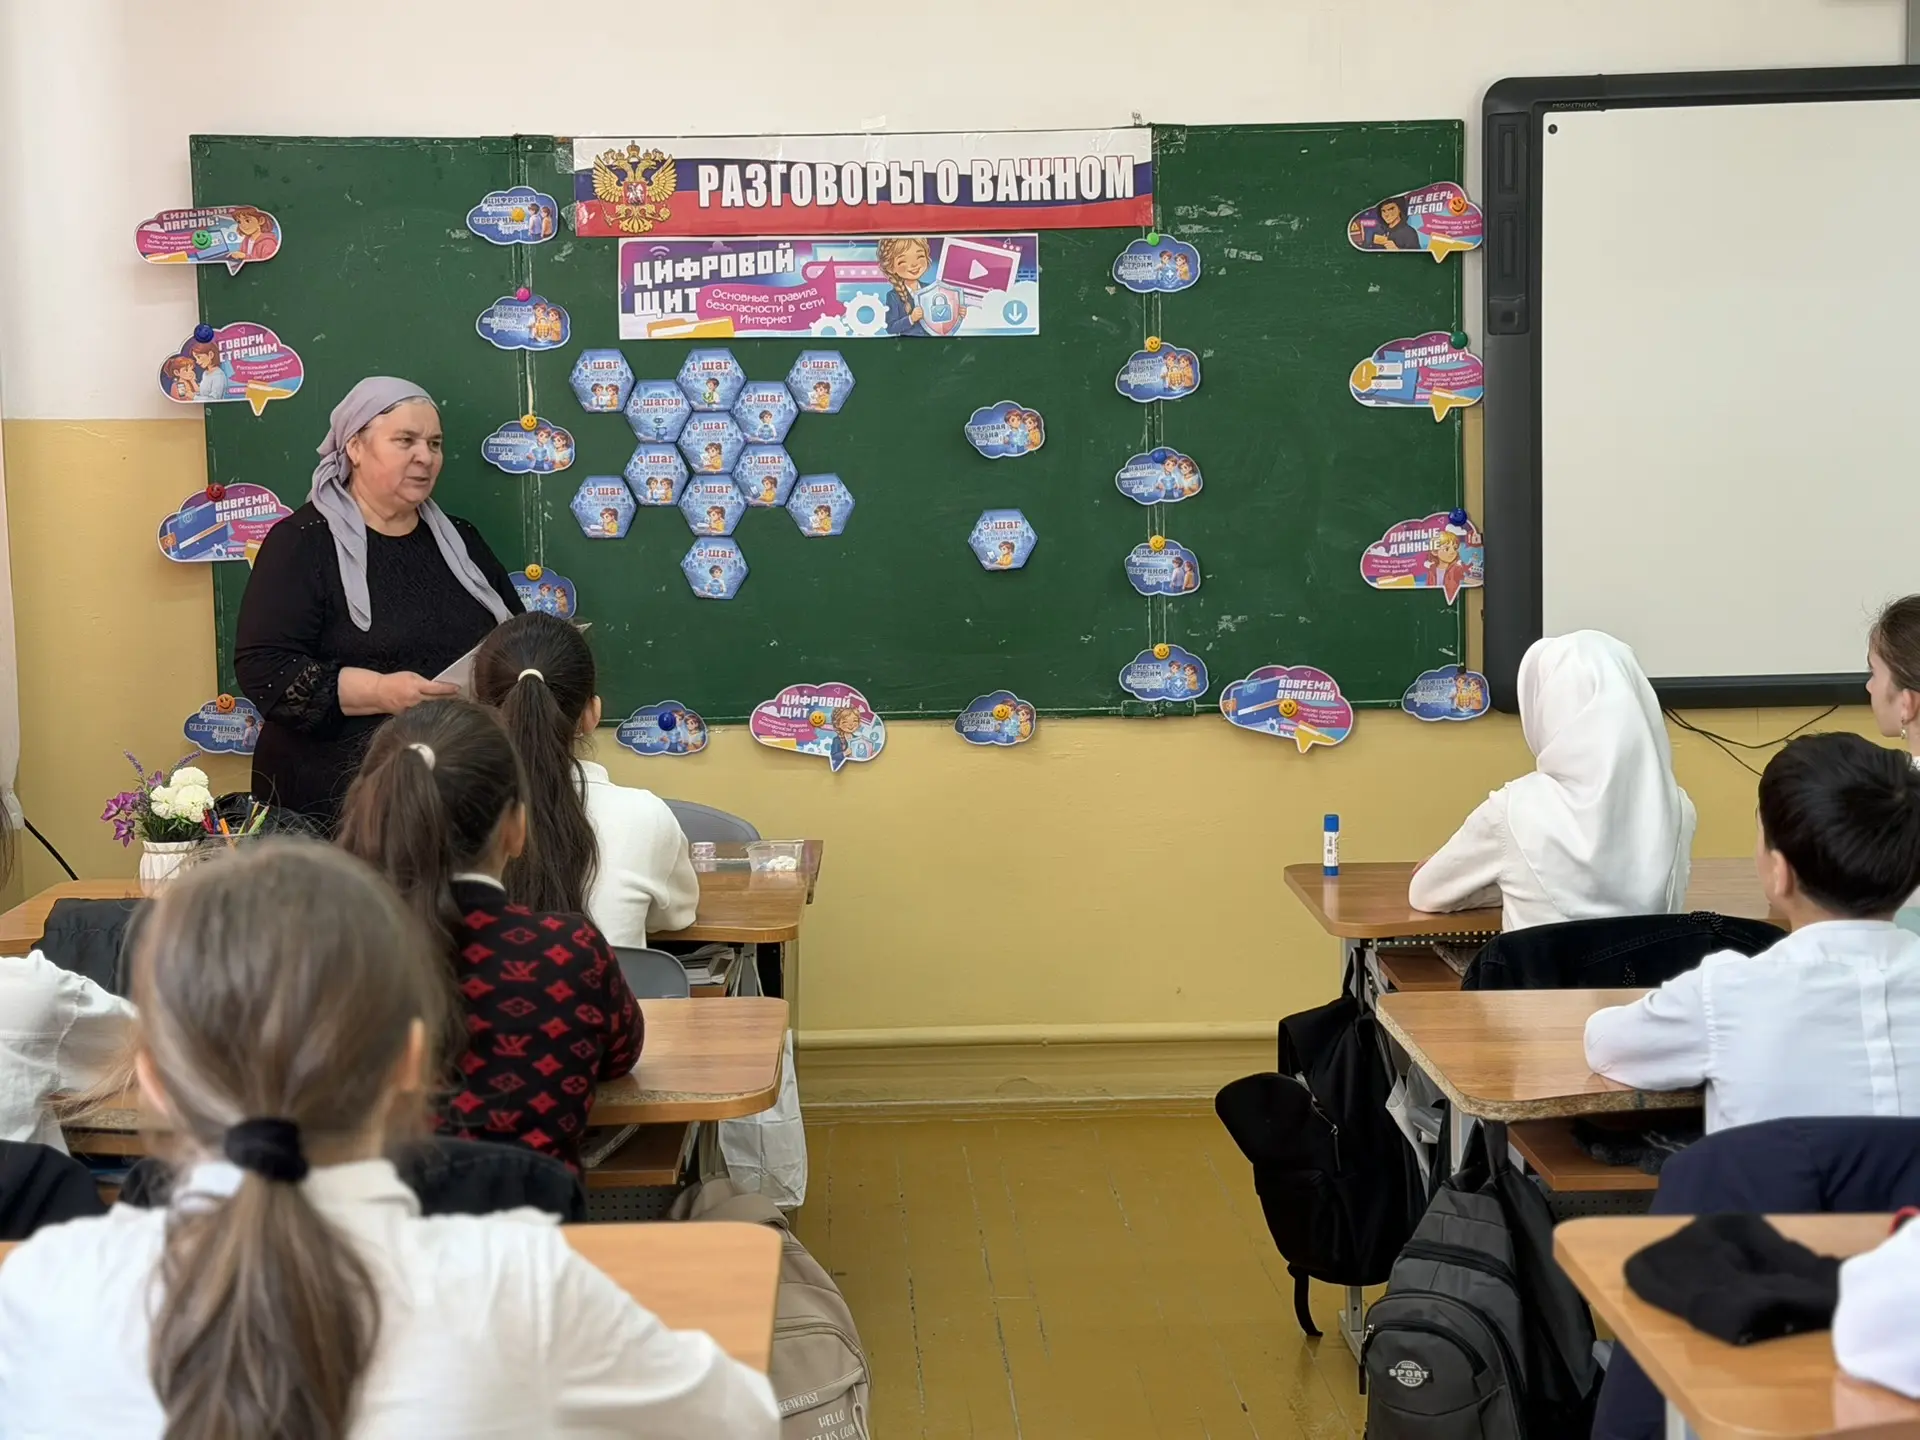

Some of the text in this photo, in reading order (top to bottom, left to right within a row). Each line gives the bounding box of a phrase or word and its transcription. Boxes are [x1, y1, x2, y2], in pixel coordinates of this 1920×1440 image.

[697, 155, 1135, 209] РАЗГОВОРЫ О ВАЖНОМ
[1408, 190, 1454, 205] НЕ ВЕРЬ
[162, 207, 228, 221] СИЛЬНЫЙ
[1407, 202, 1443, 216] СЛЕПО
[163, 217, 220, 232] ПАРОЛЬ!
[632, 243, 796, 289] ЦИФРОВОЙ
[633, 286, 701, 320] ЩИТ
[712, 287, 817, 305] Основные правила
[705, 298, 825, 313] безопасности в сети
[740, 314, 793, 327] Интернет
[218, 333, 264, 351] ГОВОРИ
[219, 343, 278, 362] СТАРШИМ
[1404, 351, 1465, 369] АНТИВИРУС
[214, 493, 270, 511] ВОВРЕМЯ
[215, 501, 277, 523] ОБНОВЛЯЙ
[1388, 527, 1441, 543] ЛИЧНЫЕ
[1388, 541, 1441, 556] ДАННЫЕ
[1278, 679, 1332, 690] ВОВРЕМЯ
[781, 694, 851, 708] ЦИФРОВОЙ
[1276, 689, 1336, 702] ОБНОВЛЯЙ
[779, 706, 810, 719] ЩИТ
[1388, 1368, 1429, 1379] SPORT
[818, 1409, 845, 1429] HELLO
